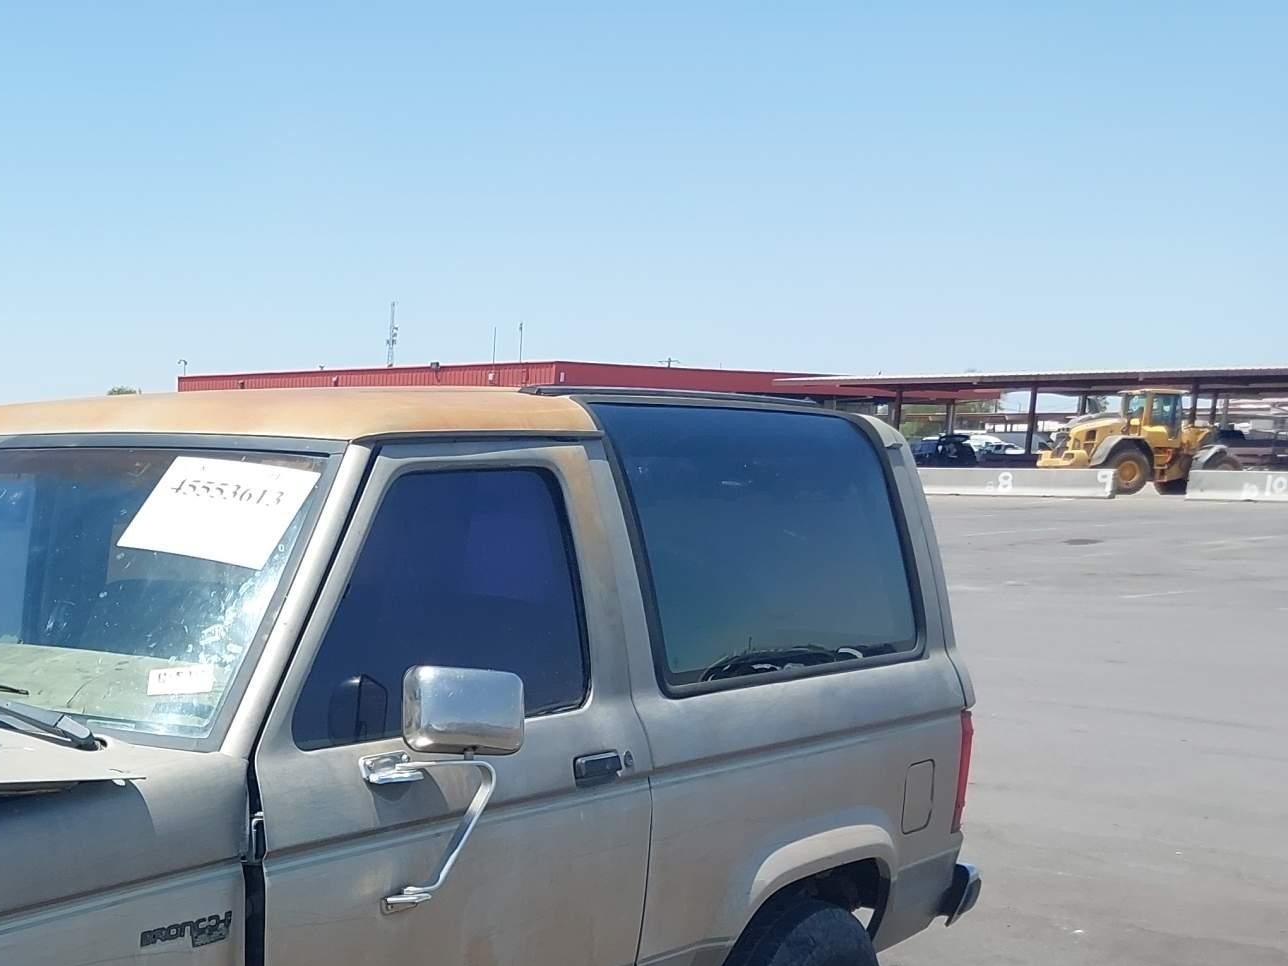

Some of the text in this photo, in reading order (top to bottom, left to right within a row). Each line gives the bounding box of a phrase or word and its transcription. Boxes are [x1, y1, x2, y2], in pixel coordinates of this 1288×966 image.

[170, 478, 285, 507] 45553613
[998, 472, 1014, 492] 8
[1098, 471, 1113, 494] 9
[1264, 474, 1288, 496] 10
